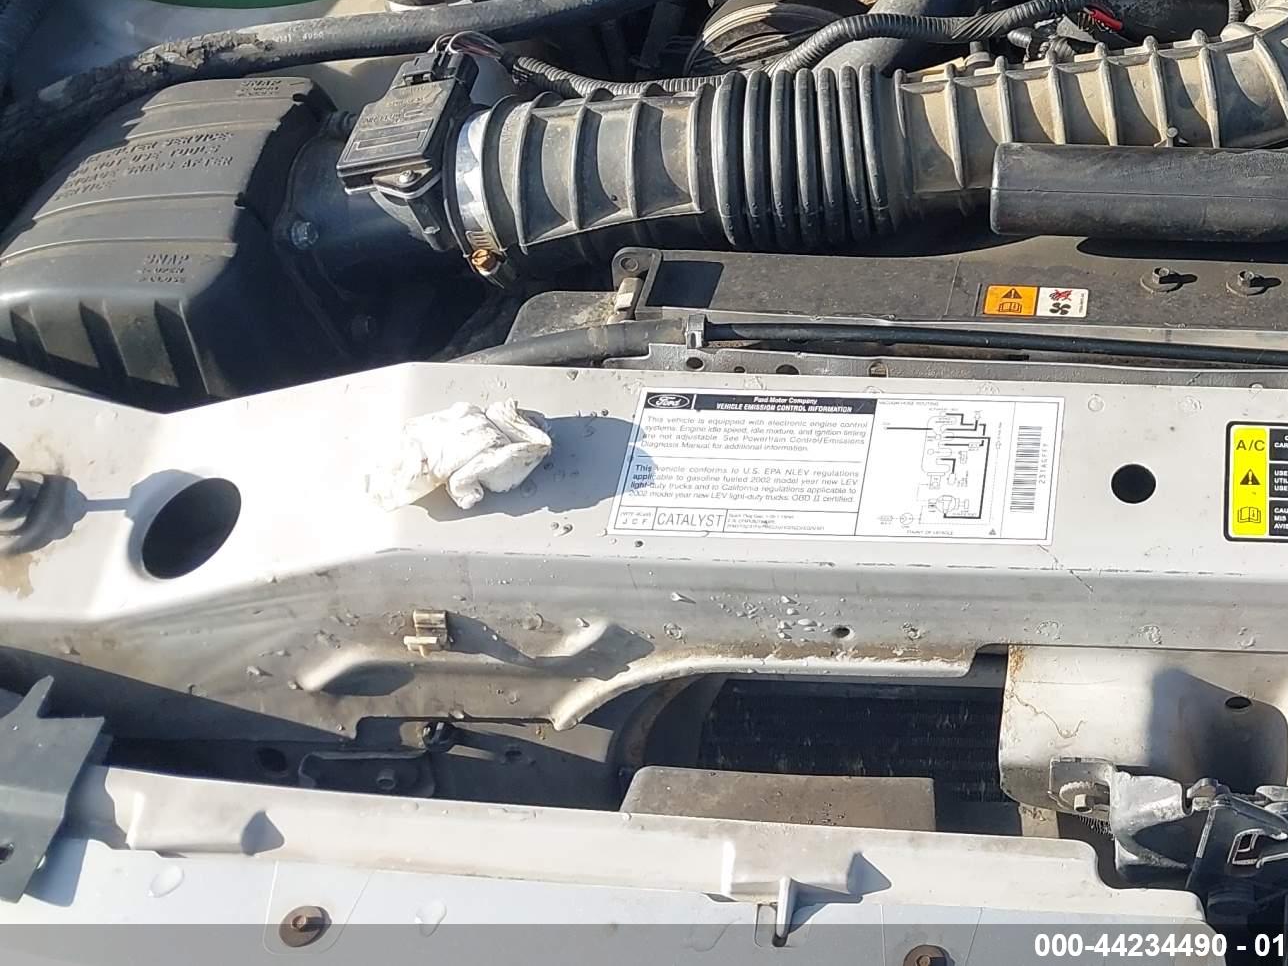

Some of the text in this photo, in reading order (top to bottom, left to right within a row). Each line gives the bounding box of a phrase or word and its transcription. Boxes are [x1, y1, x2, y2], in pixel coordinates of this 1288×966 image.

[656, 395, 682, 407] Ford
[1236, 440, 1265, 452] A/C
[657, 512, 723, 528] CATALYST
